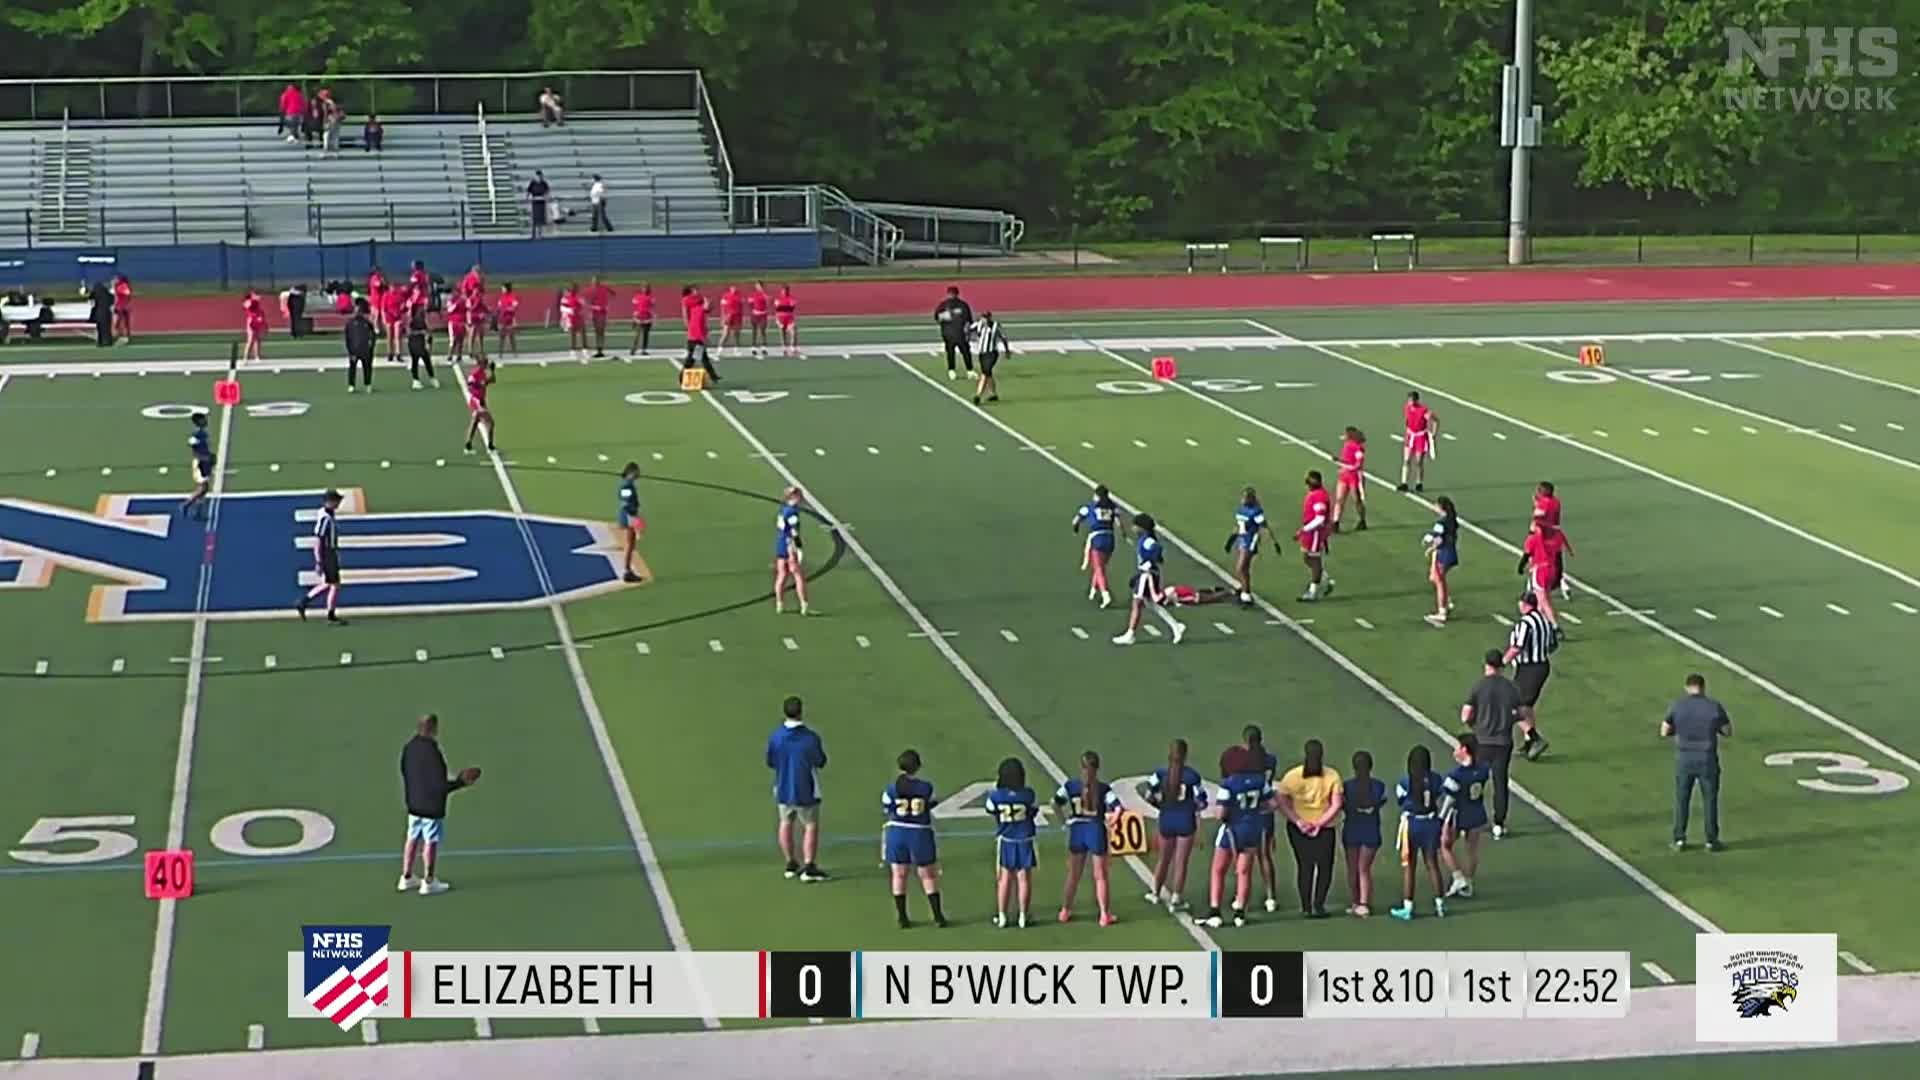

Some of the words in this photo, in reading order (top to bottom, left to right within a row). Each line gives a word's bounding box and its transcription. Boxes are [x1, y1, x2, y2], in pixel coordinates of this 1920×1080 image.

[1154, 360, 1174, 379] 20
[1236, 789, 1260, 809] 17
[997, 803, 1028, 823] 22
[1110, 814, 1142, 851] 30
[153, 856, 187, 892] 40
